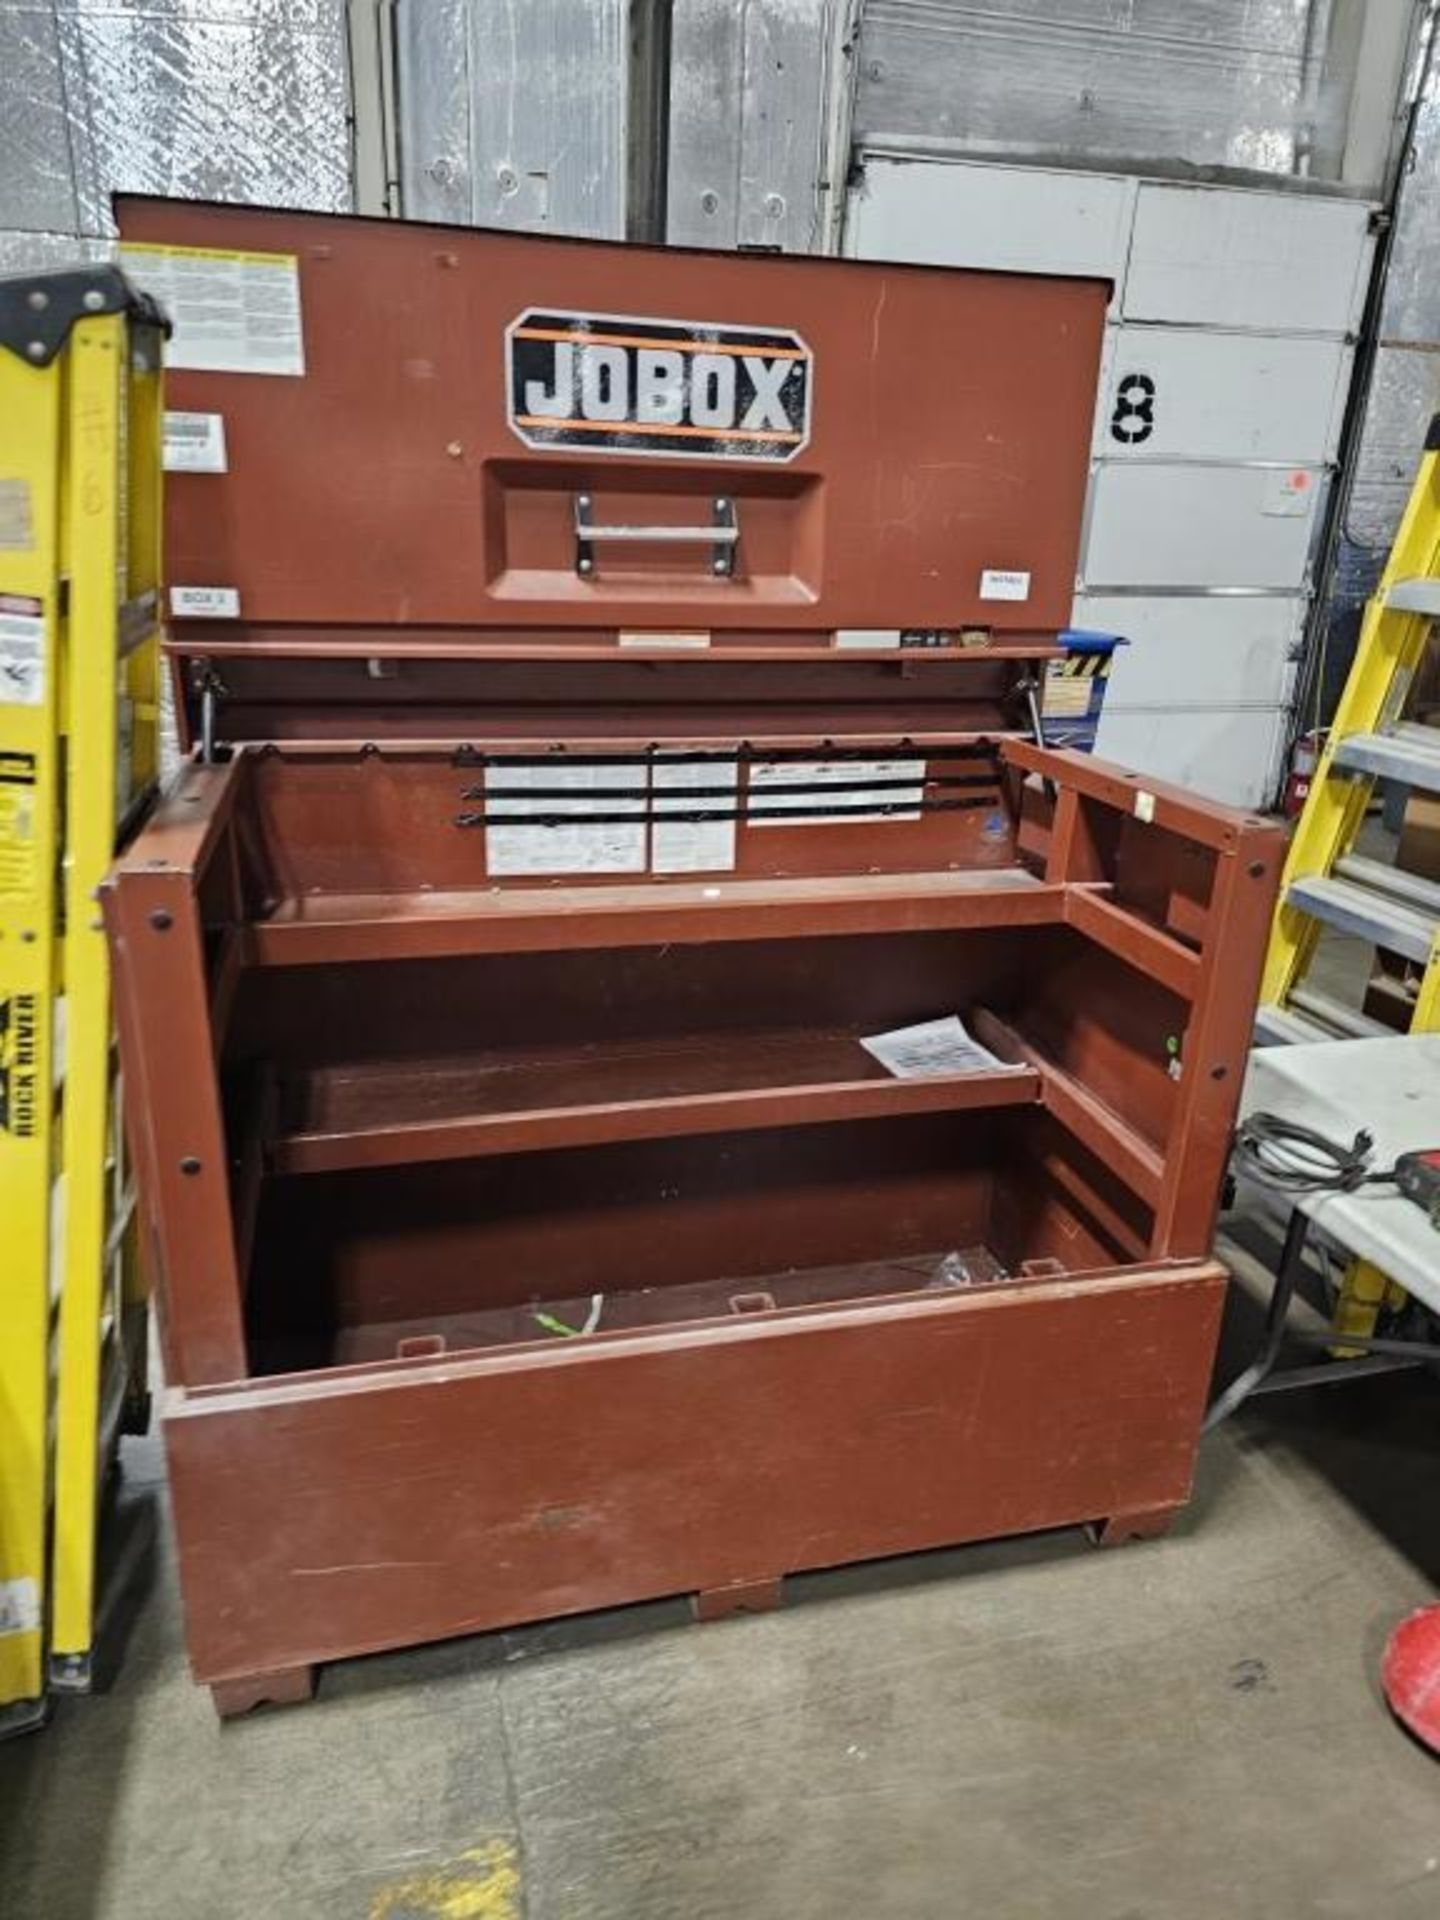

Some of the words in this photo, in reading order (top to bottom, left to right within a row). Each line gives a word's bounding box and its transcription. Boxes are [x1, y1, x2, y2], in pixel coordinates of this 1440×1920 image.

[524, 341, 795, 432] JOBOX
[1111, 373, 1155, 444] 8
[16, 992, 35, 1067] RIVER
[16, 1074, 35, 1138] ROCK
